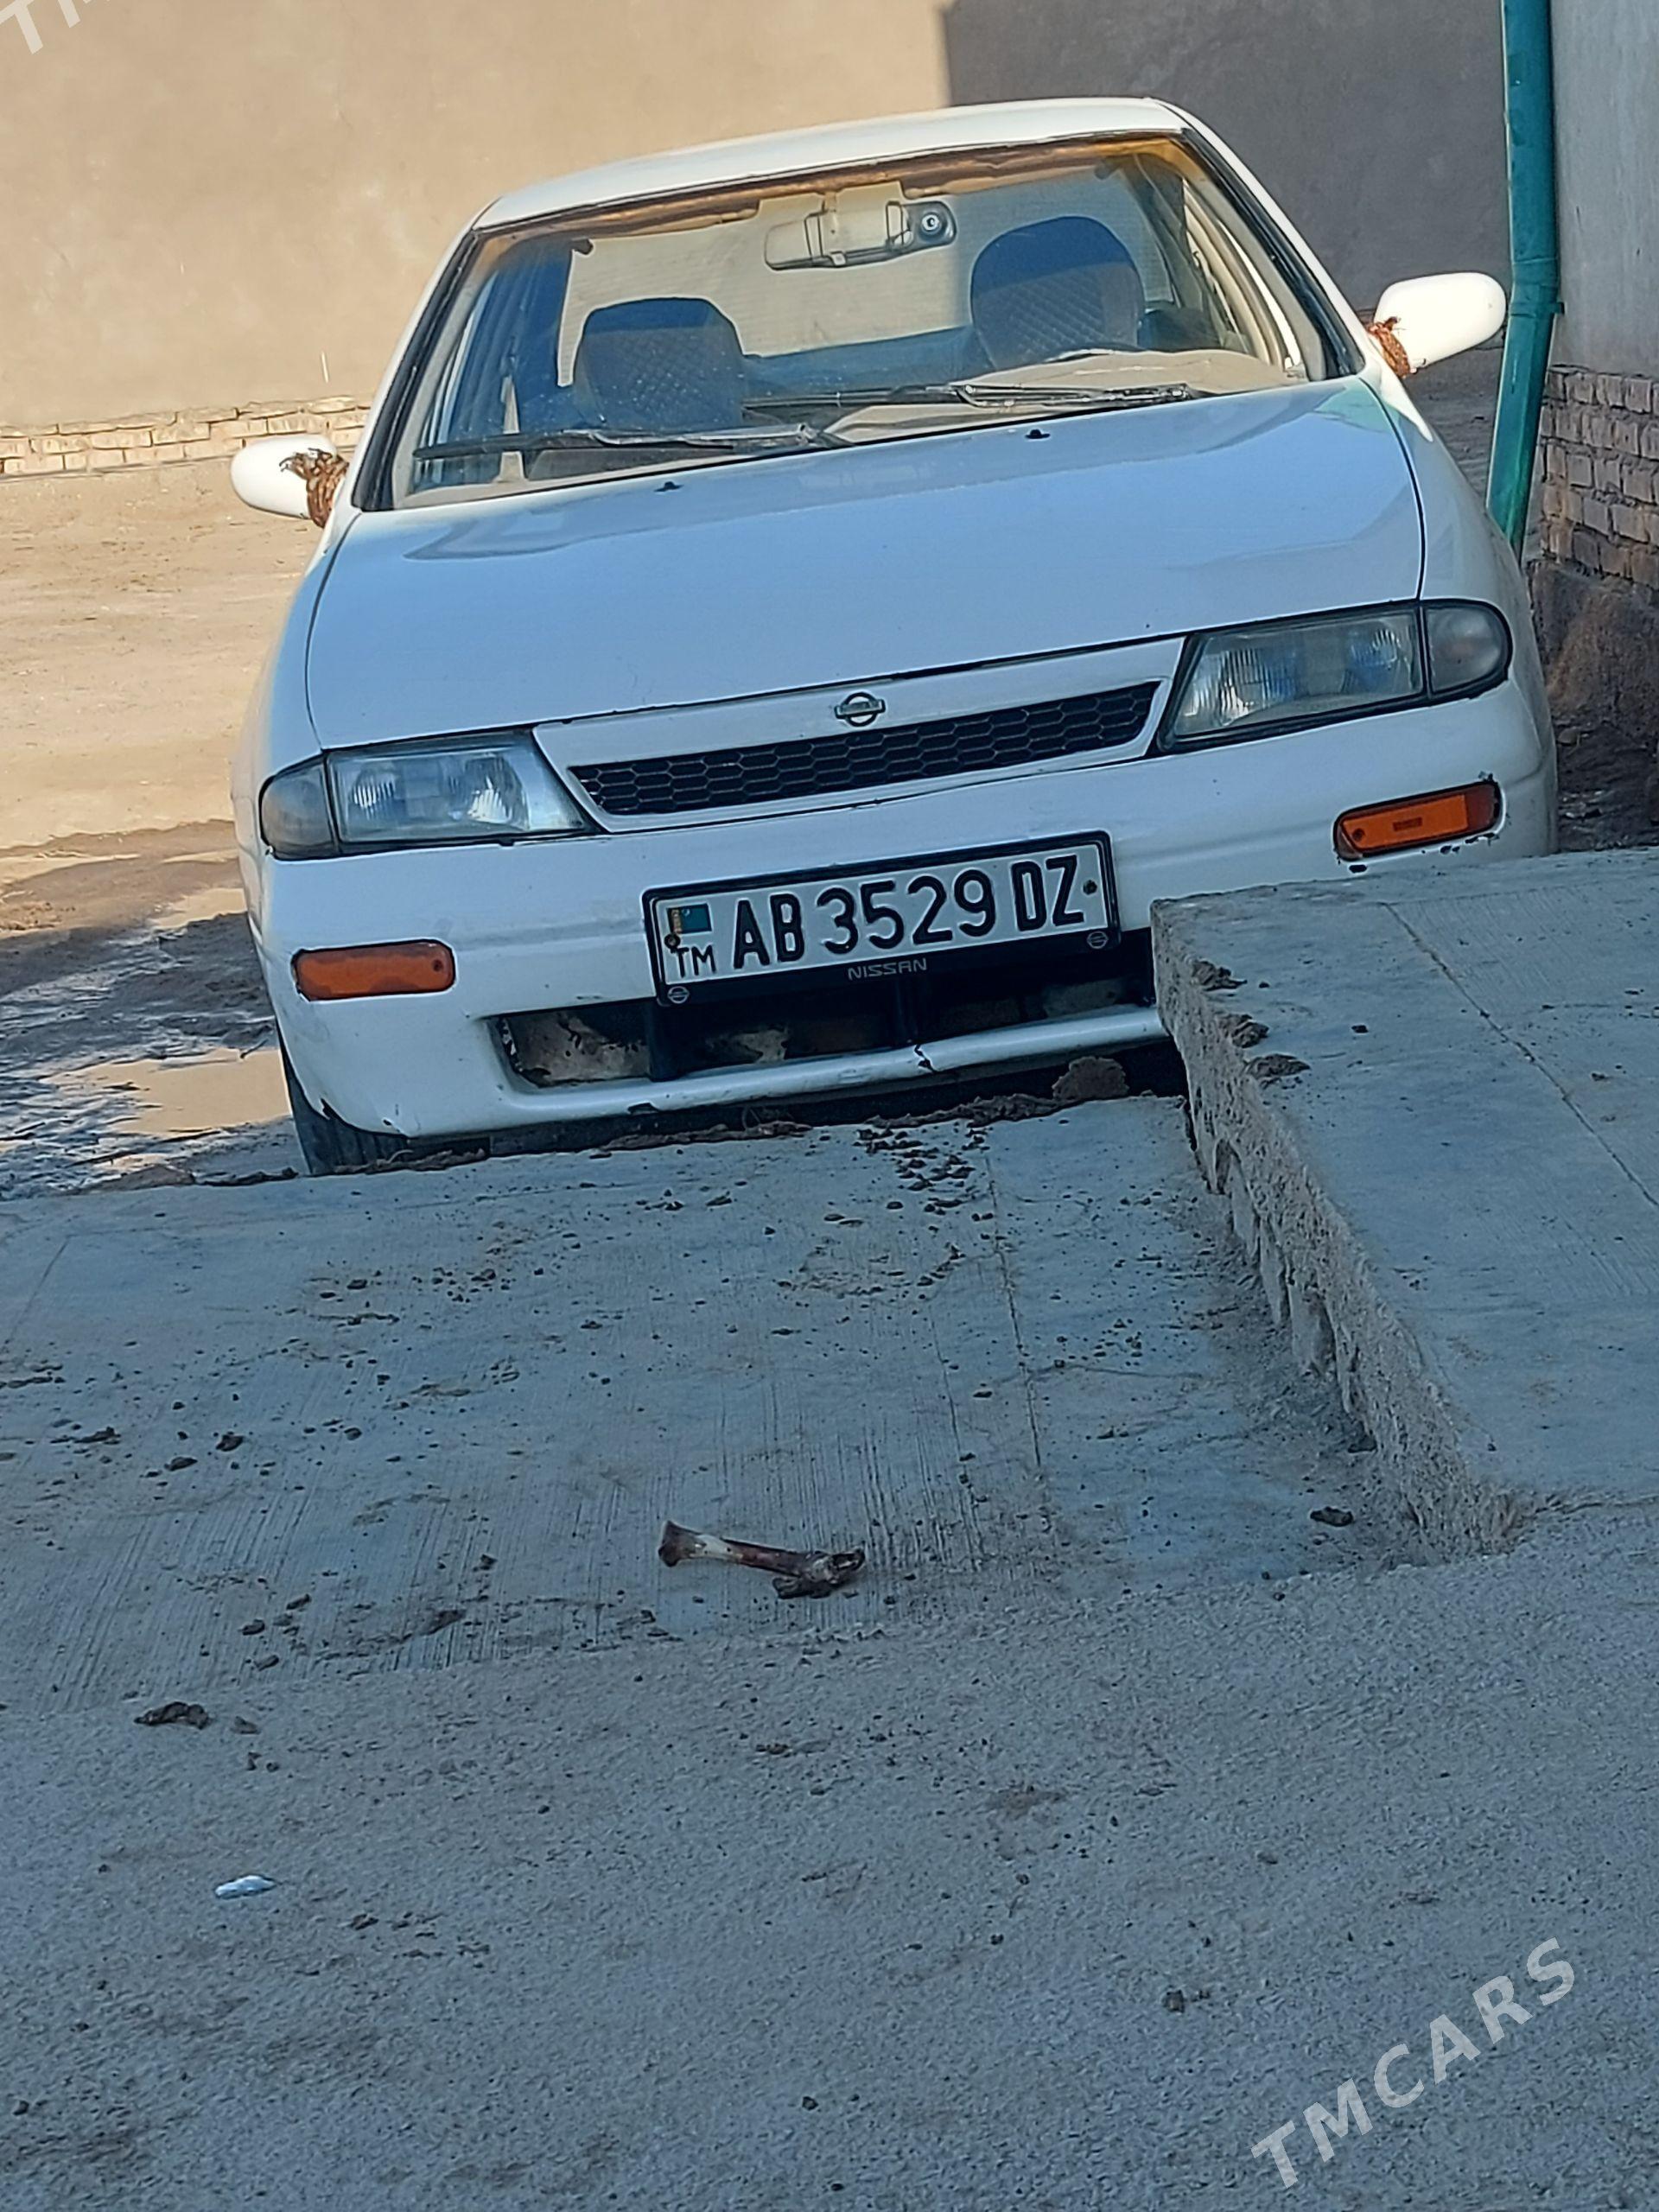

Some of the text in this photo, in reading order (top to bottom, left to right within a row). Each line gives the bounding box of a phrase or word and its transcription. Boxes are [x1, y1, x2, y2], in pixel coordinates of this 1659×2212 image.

[733, 855, 1084, 969] AB 3529 DZ
[669, 944, 717, 978] TM
[848, 957, 927, 981] NISSAN
